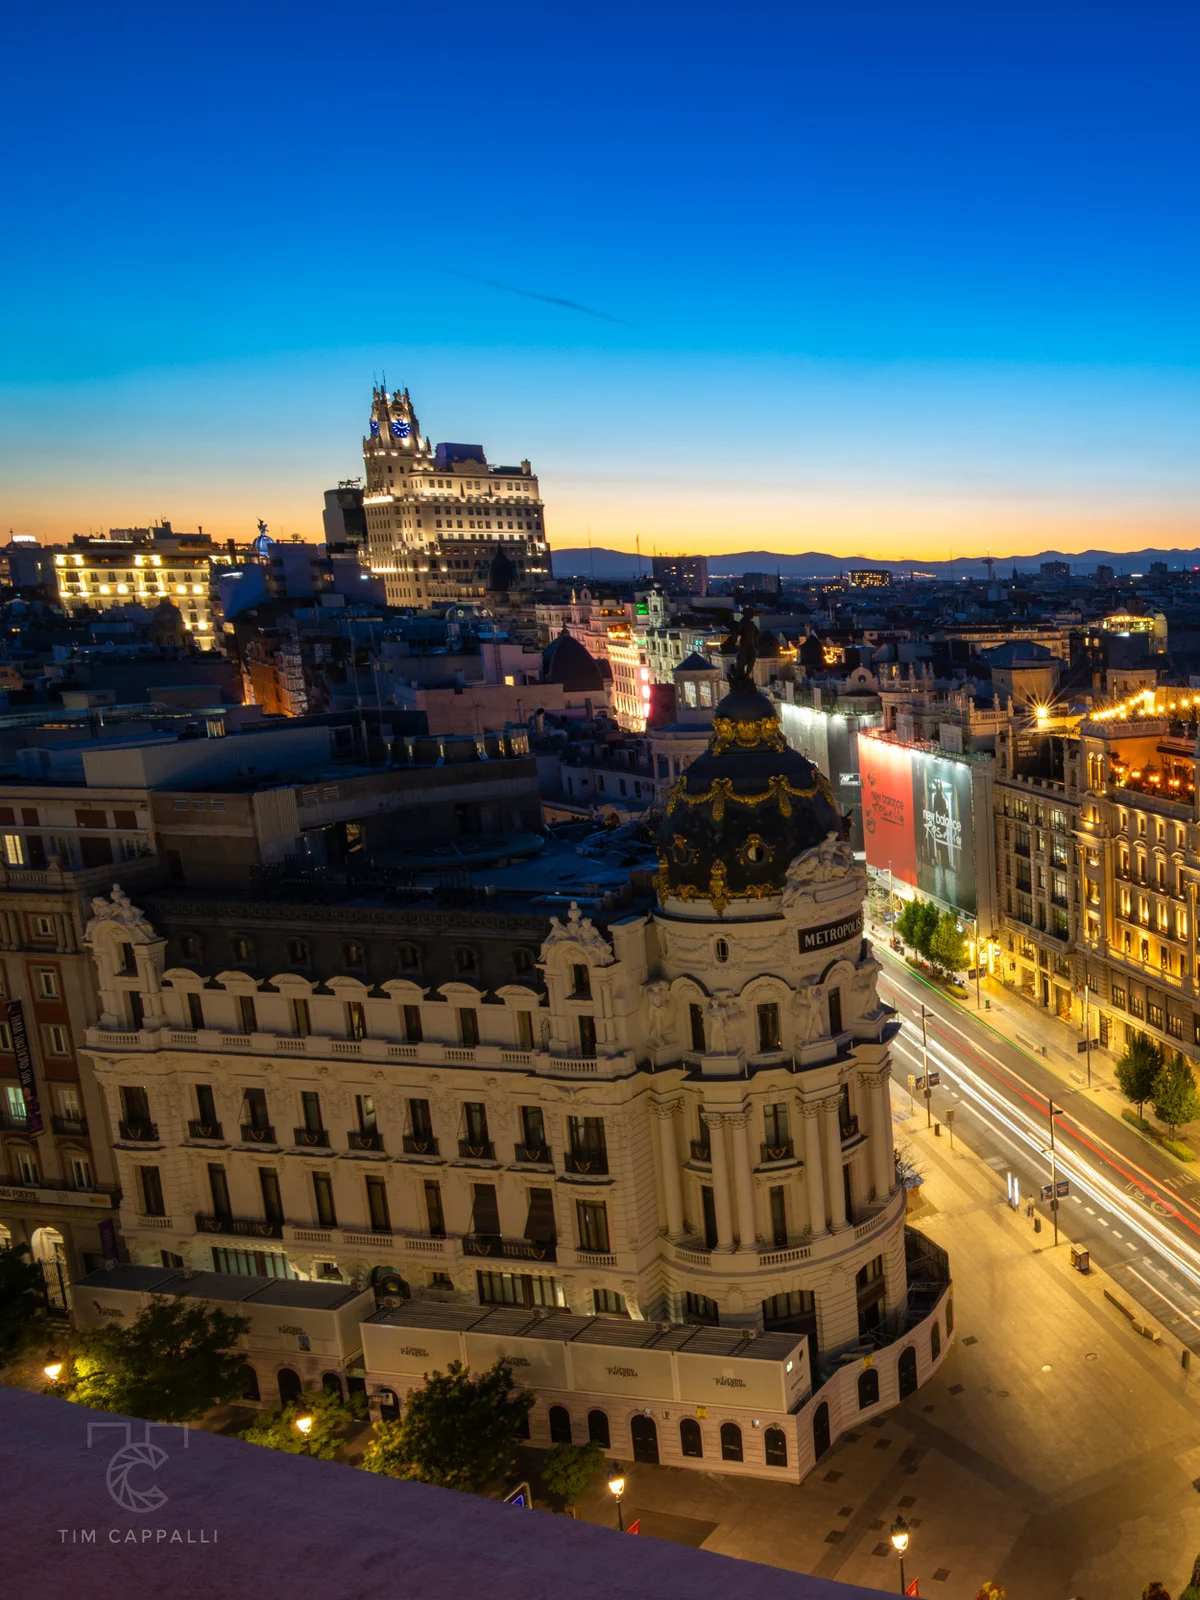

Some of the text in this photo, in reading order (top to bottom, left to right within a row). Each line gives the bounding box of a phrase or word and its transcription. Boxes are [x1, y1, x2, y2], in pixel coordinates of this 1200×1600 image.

[882, 792, 904, 810] balance
[923, 810, 962, 831] new balance
[804, 917, 861, 947] METROPOLIS
[1163, 1173, 1196, 1189] TAXI
